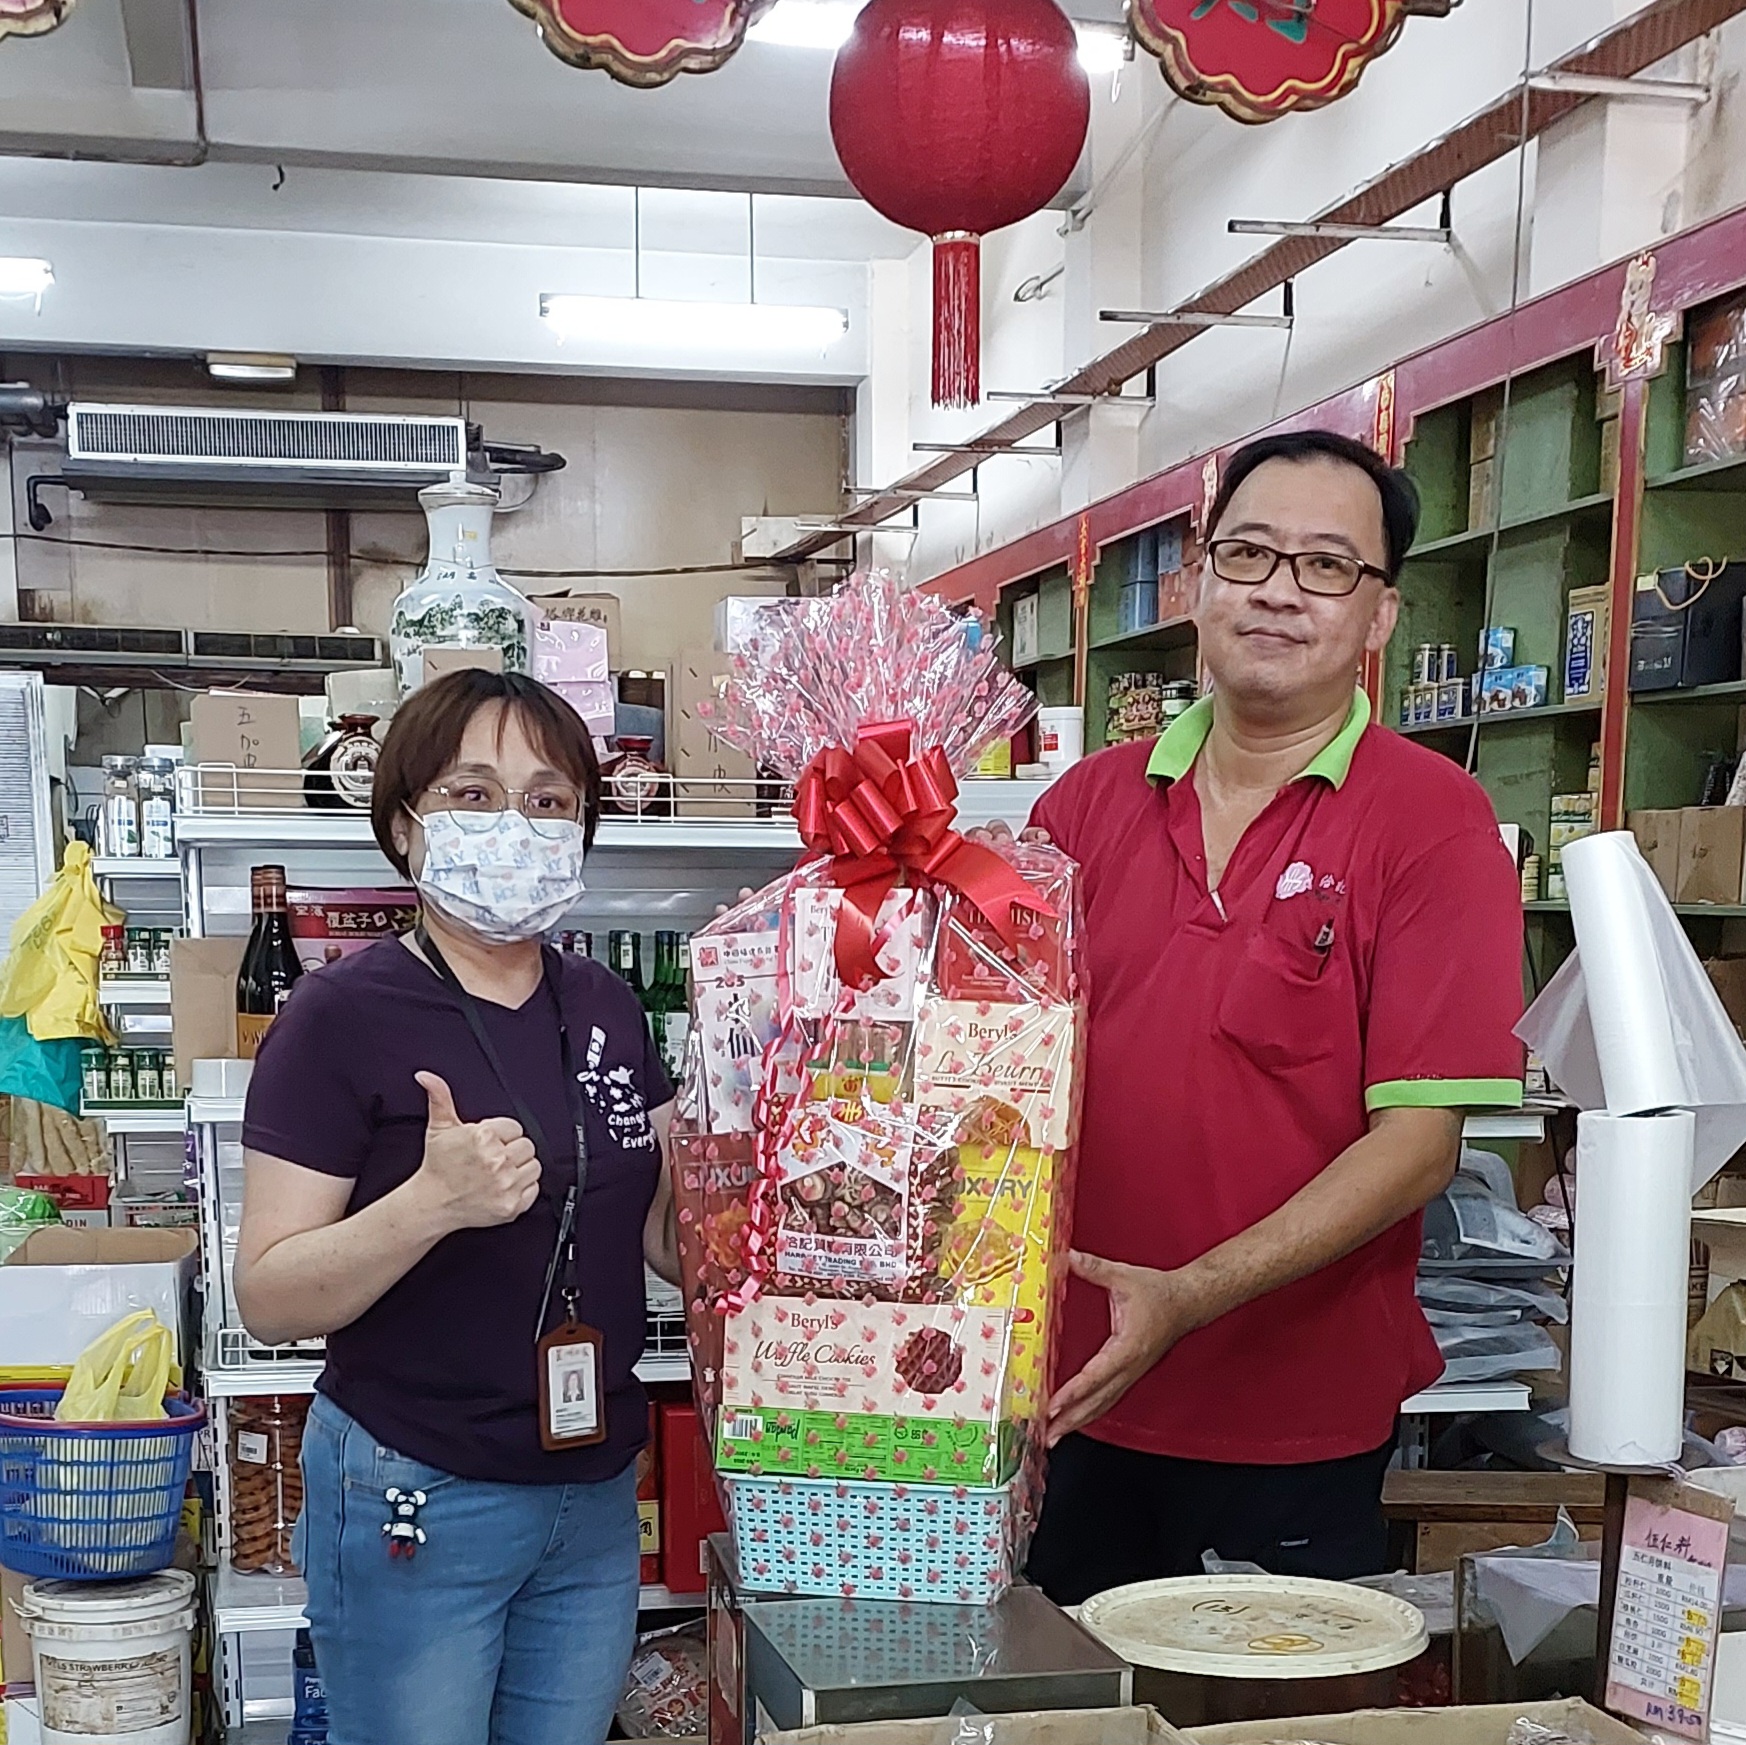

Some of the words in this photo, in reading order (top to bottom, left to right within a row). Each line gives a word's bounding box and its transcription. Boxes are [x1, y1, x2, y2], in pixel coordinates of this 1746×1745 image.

[824, 1255, 857, 1266] TRADING
[879, 1260, 897, 1268] BHD
[791, 1312, 839, 1333] Beryl's
[754, 1339, 811, 1368] Wffle
[69, 1661, 133, 1673] STRAWBERR
